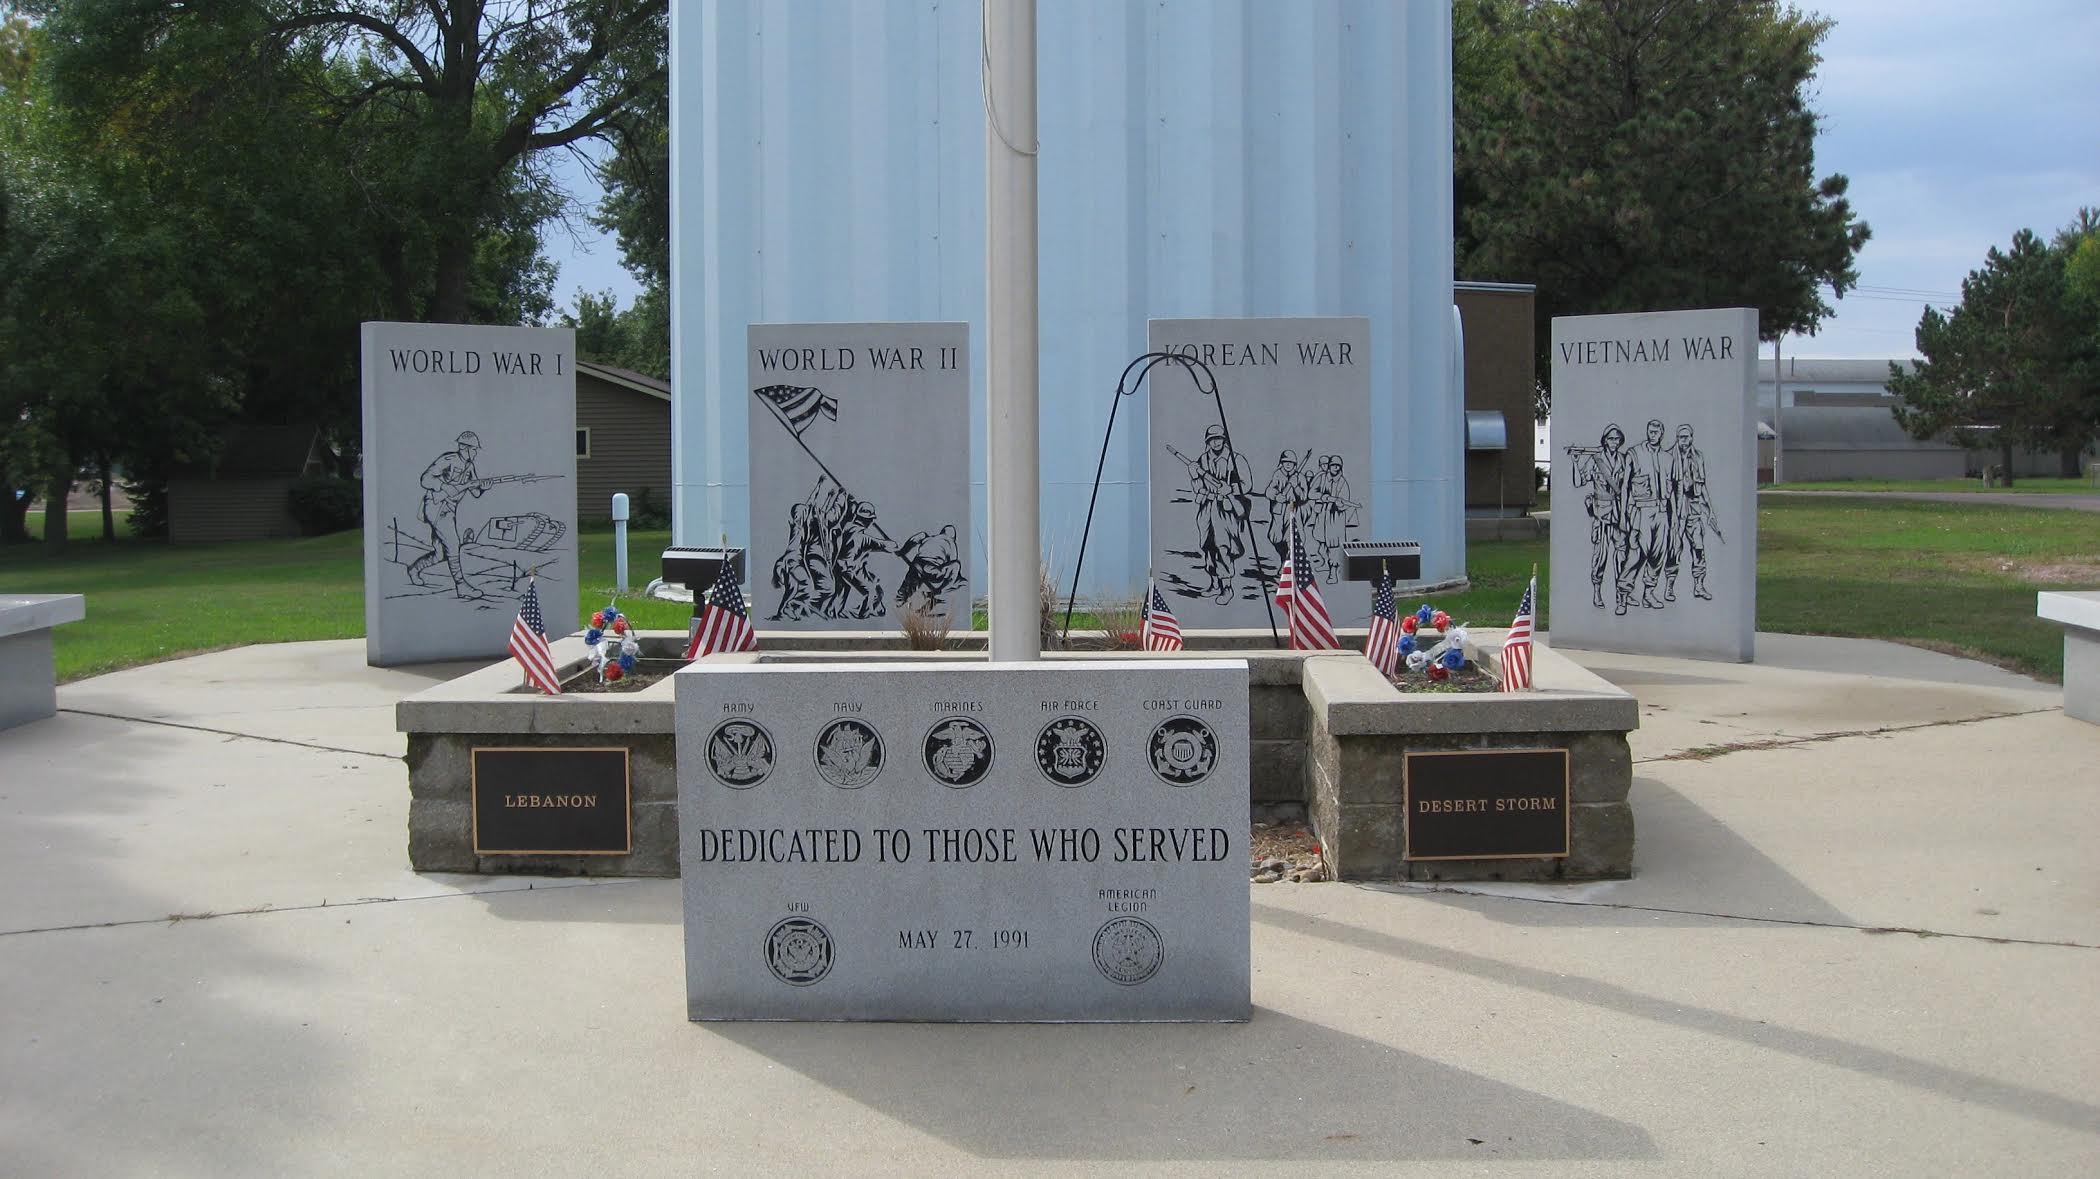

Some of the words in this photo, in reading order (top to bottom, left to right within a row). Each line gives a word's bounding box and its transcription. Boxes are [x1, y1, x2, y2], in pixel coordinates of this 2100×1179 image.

[1164, 343, 1279, 367] KOREAN
[1296, 342, 1354, 366] WAR
[1560, 339, 1670, 365] VIETNAM
[1683, 336, 1735, 361] WAR
[389, 349, 481, 374] WORLD
[492, 351, 543, 375] WAR
[555, 353, 563, 376] I
[758, 348, 855, 371] WORLD
[868, 347, 925, 371] WAR
[940, 347, 957, 370] II
[723, 703, 755, 713] ARMY
[833, 702, 863, 713] NAVY
[934, 701, 983, 712] MARINES
[1041, 701, 1058, 711] AIR
[1064, 700, 1100, 711] FORCE
[1143, 700, 1178, 711] COAST
[1184, 699, 1223, 711] GUARD
[505, 795, 597, 808] LEBANON
[1419, 799, 1488, 813] DESERT
[1495, 797, 1556, 812] STORM
[699, 828, 861, 863] DEDICATED
[874, 828, 911, 863] TO
[923, 828, 1017, 863] THOSE
[1030, 828, 1101, 863] WHO
[1113, 828, 1230, 863] SERVED
[1098, 889, 1157, 900] AMERICAN
[787, 902, 810, 912] VFW
[1108, 902, 1147, 912] LEGION
[899, 930, 939, 949] MAY
[993, 930, 1029, 949] 1991
